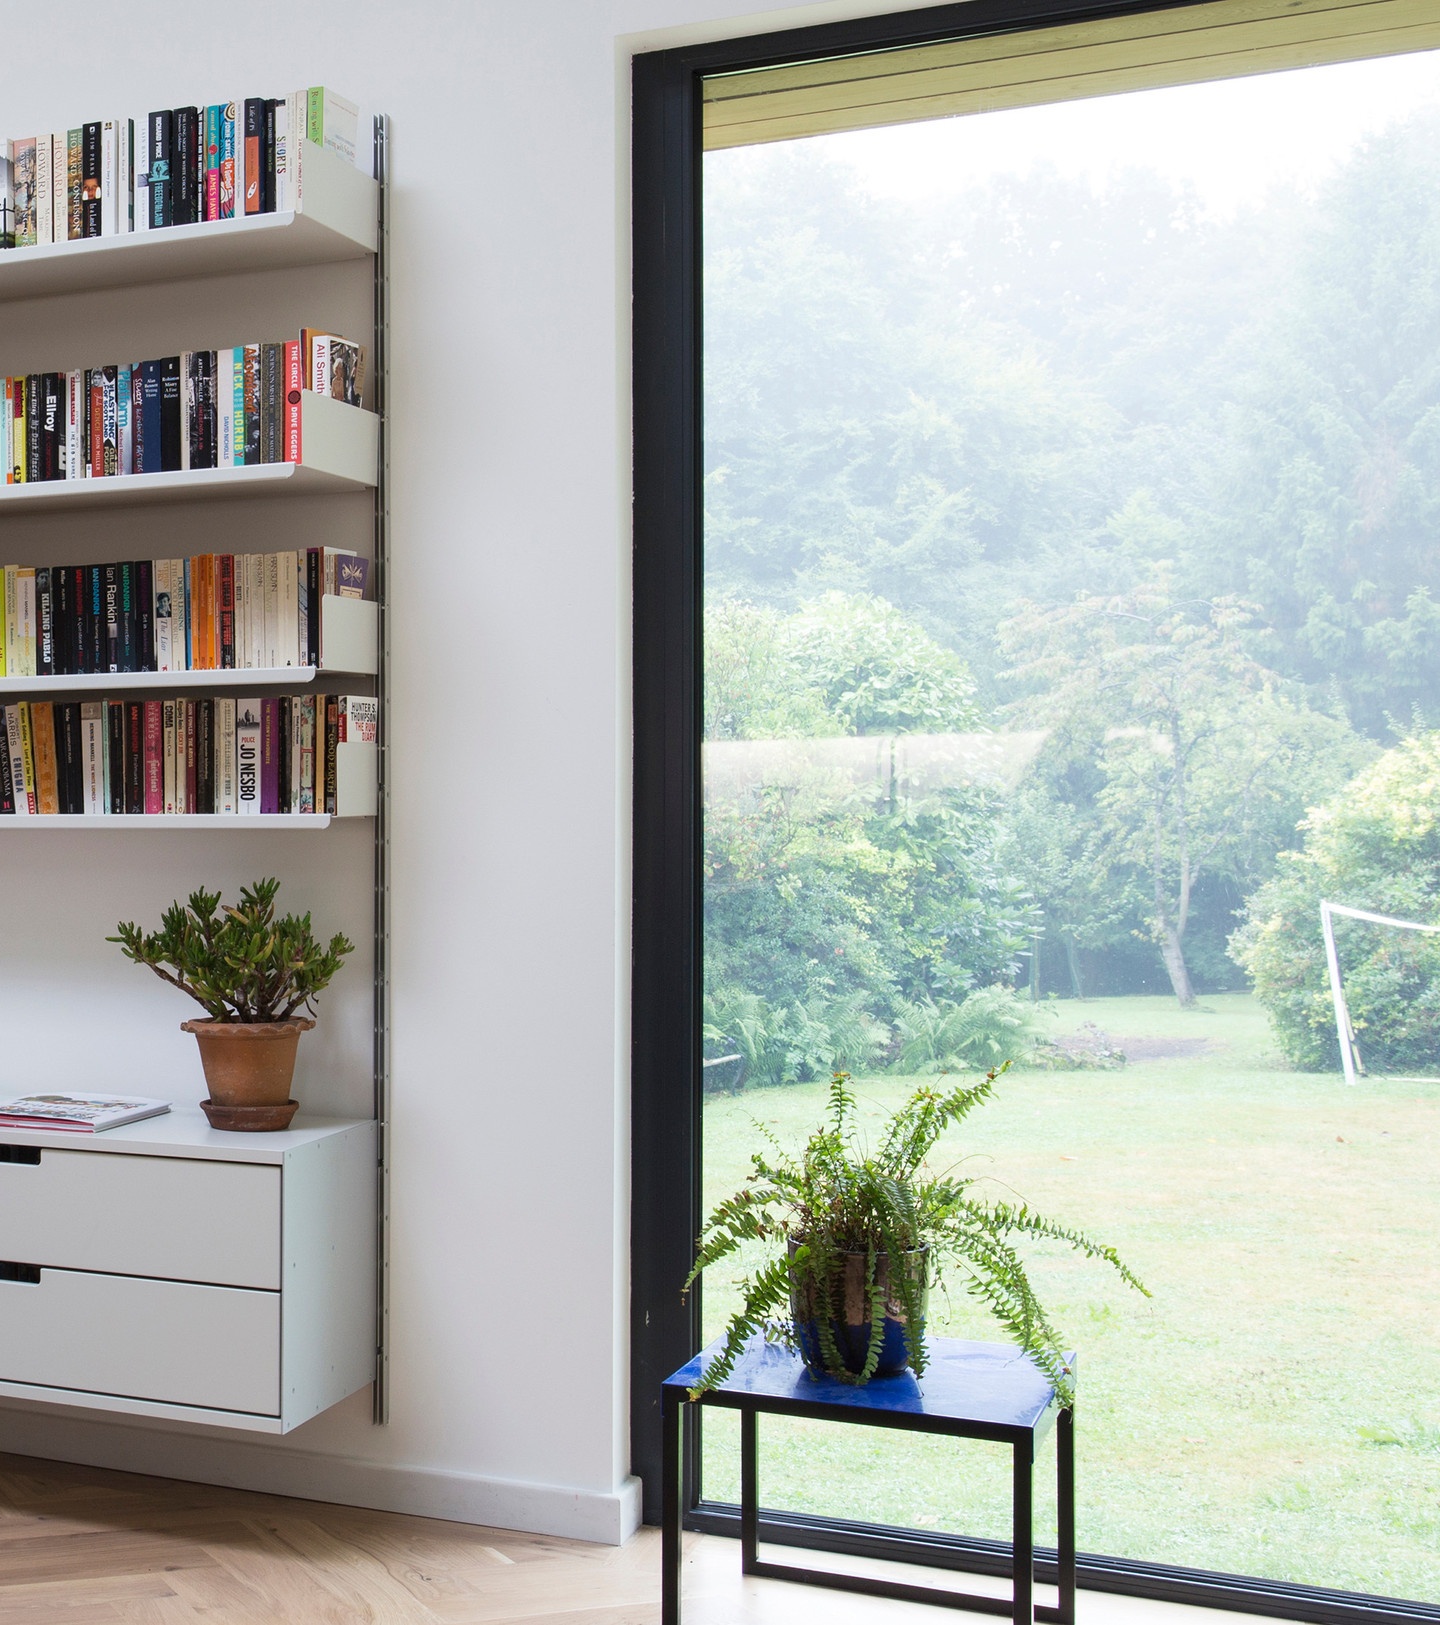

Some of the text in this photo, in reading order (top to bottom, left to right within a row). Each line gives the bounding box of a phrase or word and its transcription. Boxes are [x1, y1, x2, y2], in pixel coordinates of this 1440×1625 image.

[38, 142, 46, 199] HOWARD
[277, 136, 286, 174] SHORTS
[316, 344, 325, 394] Ali Smith
[104, 390, 108, 399] OF
[118, 371, 130, 427] Platform
[134, 378, 143, 405] Stuart
[234, 363, 243, 457] NICK HORNBY
[44, 395, 57, 432] Ellroy
[42, 593, 50, 630] KILLING
[107, 567, 117, 623] Ian Rankin
[160, 619, 168, 633] The
[165, 705, 173, 728] COMA
[351, 702, 371, 712] HUNTER
[351, 712, 376, 722] THOMPSON
[355, 722, 376, 731] THE RUM
[362, 732, 375, 742] DIARY
[0, 736, 11, 796] BARACK OBAMA
[8, 713, 23, 793] HARRIS ENIGMA
[240, 744, 255, 801] JO NESBO
